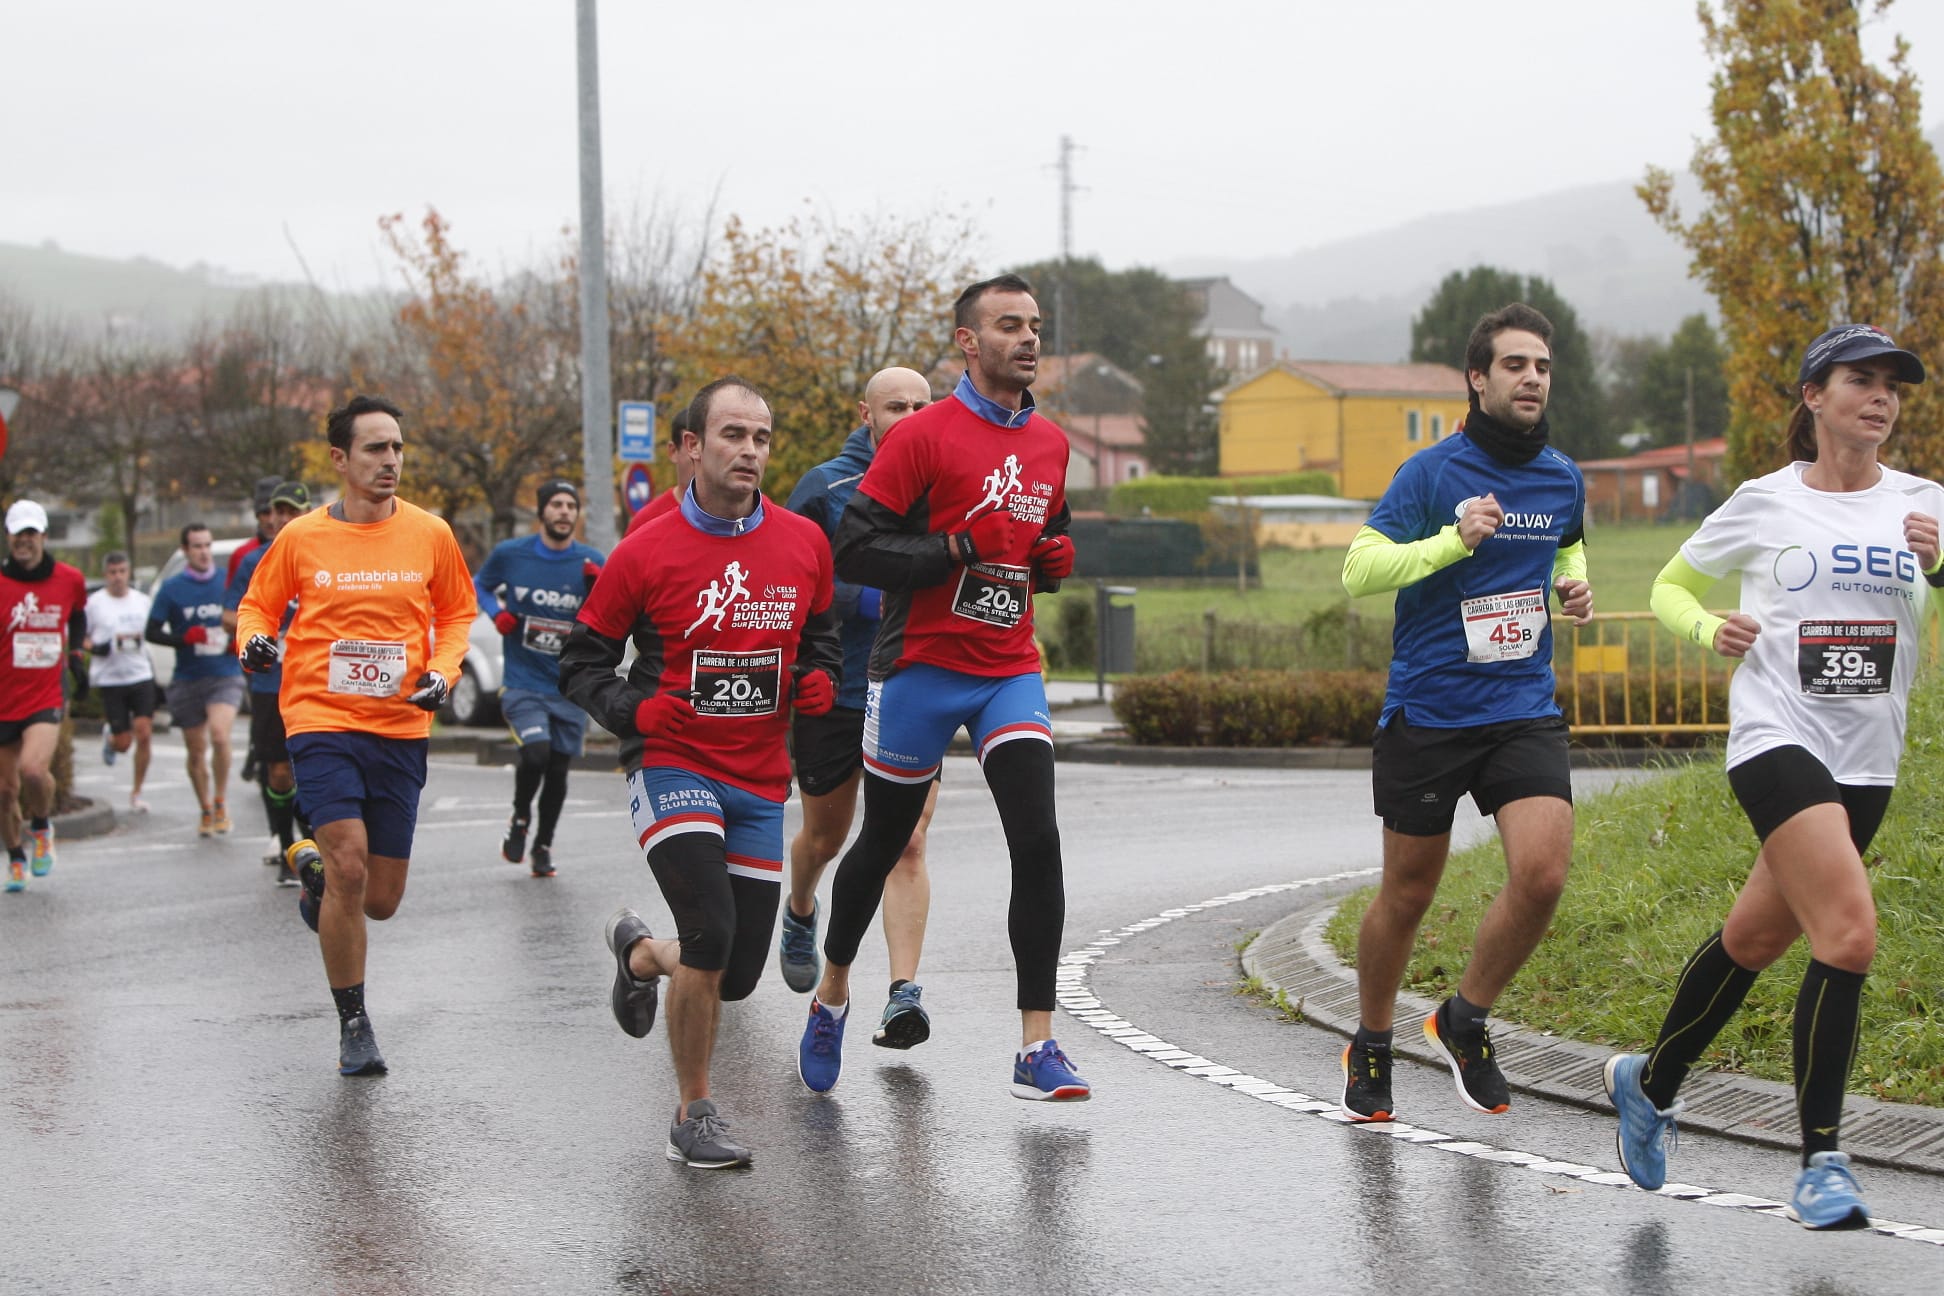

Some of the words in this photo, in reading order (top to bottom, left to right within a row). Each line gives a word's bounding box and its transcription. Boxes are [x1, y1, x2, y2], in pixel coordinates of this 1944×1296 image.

[1501, 512, 1553, 529] OLVAY
[1832, 544, 1915, 583] SEG
[337, 570, 398, 582] cantabria
[401, 570, 423, 582] labs
[1832, 582, 1913, 600] AUTOMOTIVE
[976, 586, 1019, 612] 20B
[734, 602, 796, 612] TOGETHER
[962, 602, 990, 614] GLOBAL
[1468, 604, 1494, 615] CARRERA
[1504, 601, 1514, 609] LAS
[733, 611, 790, 622] BUILDING
[748, 620, 793, 630] FUTURE
[1802, 626, 1832, 636] CARRERA
[1834, 626, 1843, 636] DE
[1846, 626, 1858, 636] LAS
[1489, 622, 1532, 644] 45B
[1499, 643, 1523, 651] SOLVAY
[700, 657, 726, 667] CARRERA
[727, 658, 736, 667] DE
[737, 658, 748, 667] LAS
[749, 655, 776, 667] EMPRESAS
[1822, 652, 1876, 677] 39B
[348, 662, 390, 682] 30D
[713, 680, 763, 700] 20A
[660, 800, 688, 811] CLUB
